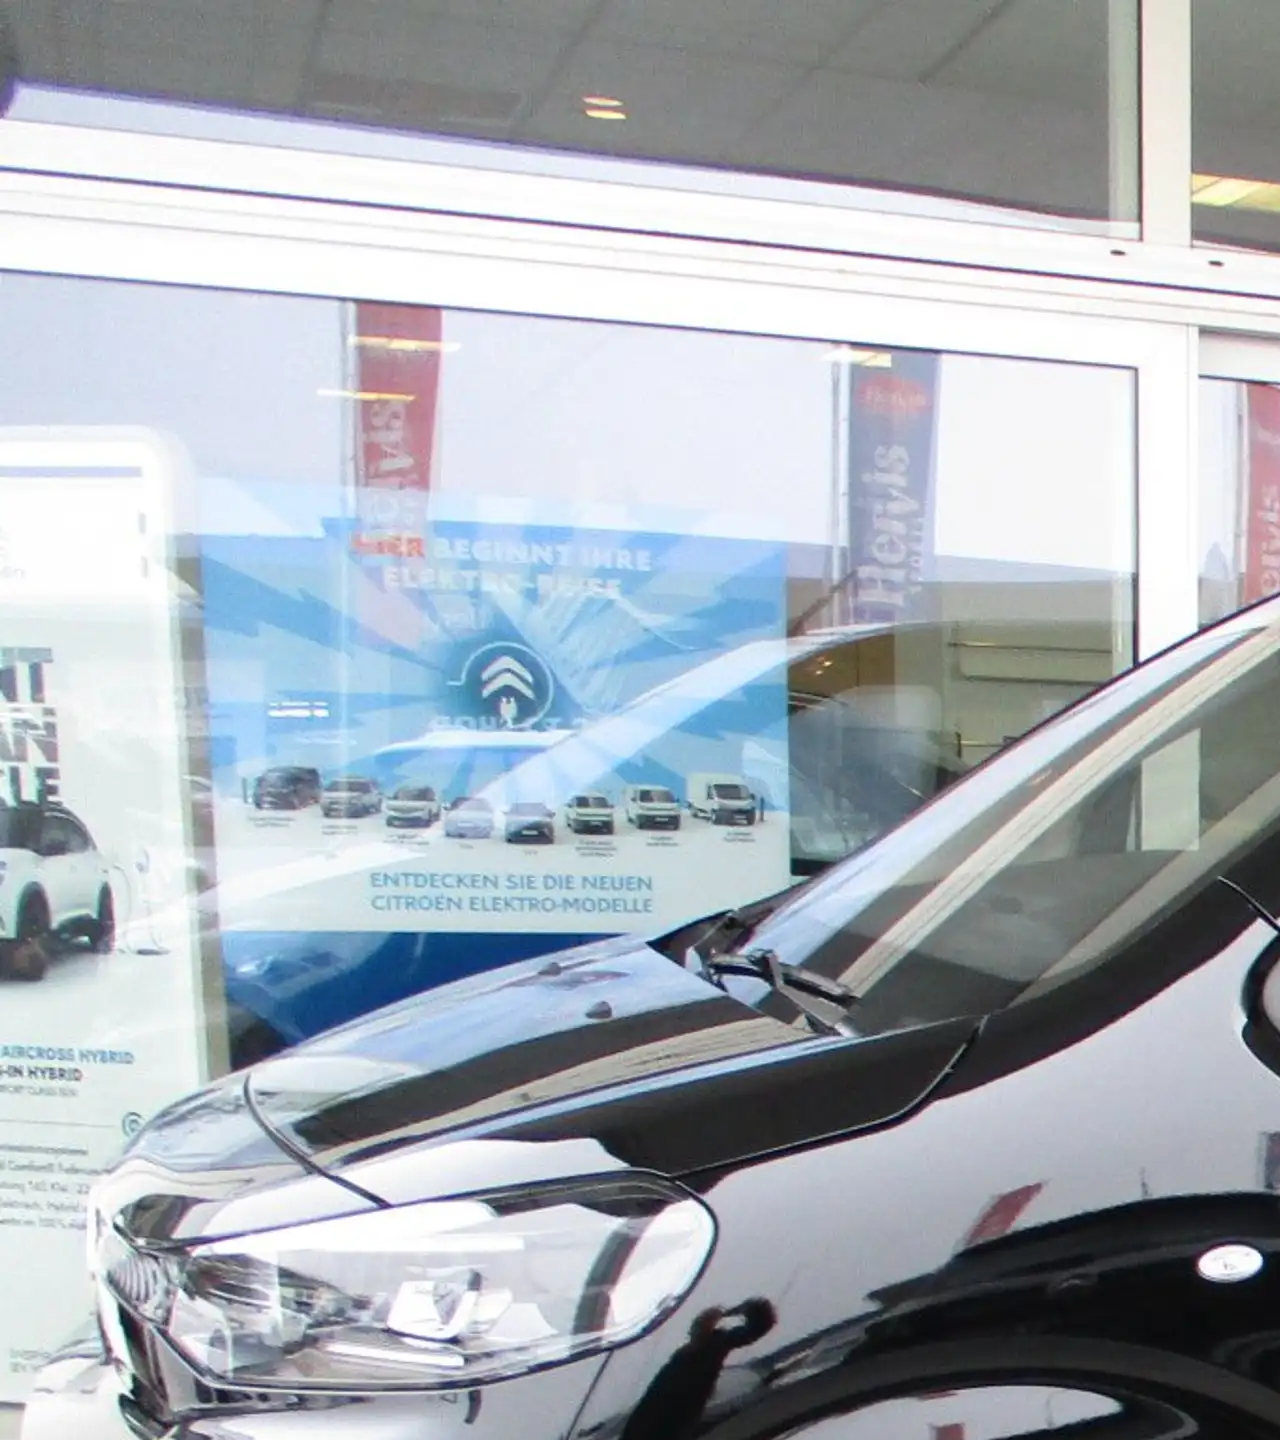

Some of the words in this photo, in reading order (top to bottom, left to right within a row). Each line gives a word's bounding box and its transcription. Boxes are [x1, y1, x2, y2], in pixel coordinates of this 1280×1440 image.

[432, 538, 567, 565] BEGINNT
[580, 547, 653, 571] IHRE
[370, 872, 498, 890] ENTDECKEN
[507, 873, 544, 890] SIE
[547, 873, 587, 891] DIE
[588, 874, 652, 892] NEUEN
[371, 894, 459, 912] CITROËN
[468, 896, 653, 913] ELEKTRO-MODELLE
[79, 1050, 135, 1065] HYBRID
[27, 1066, 83, 1082] HYBRID
